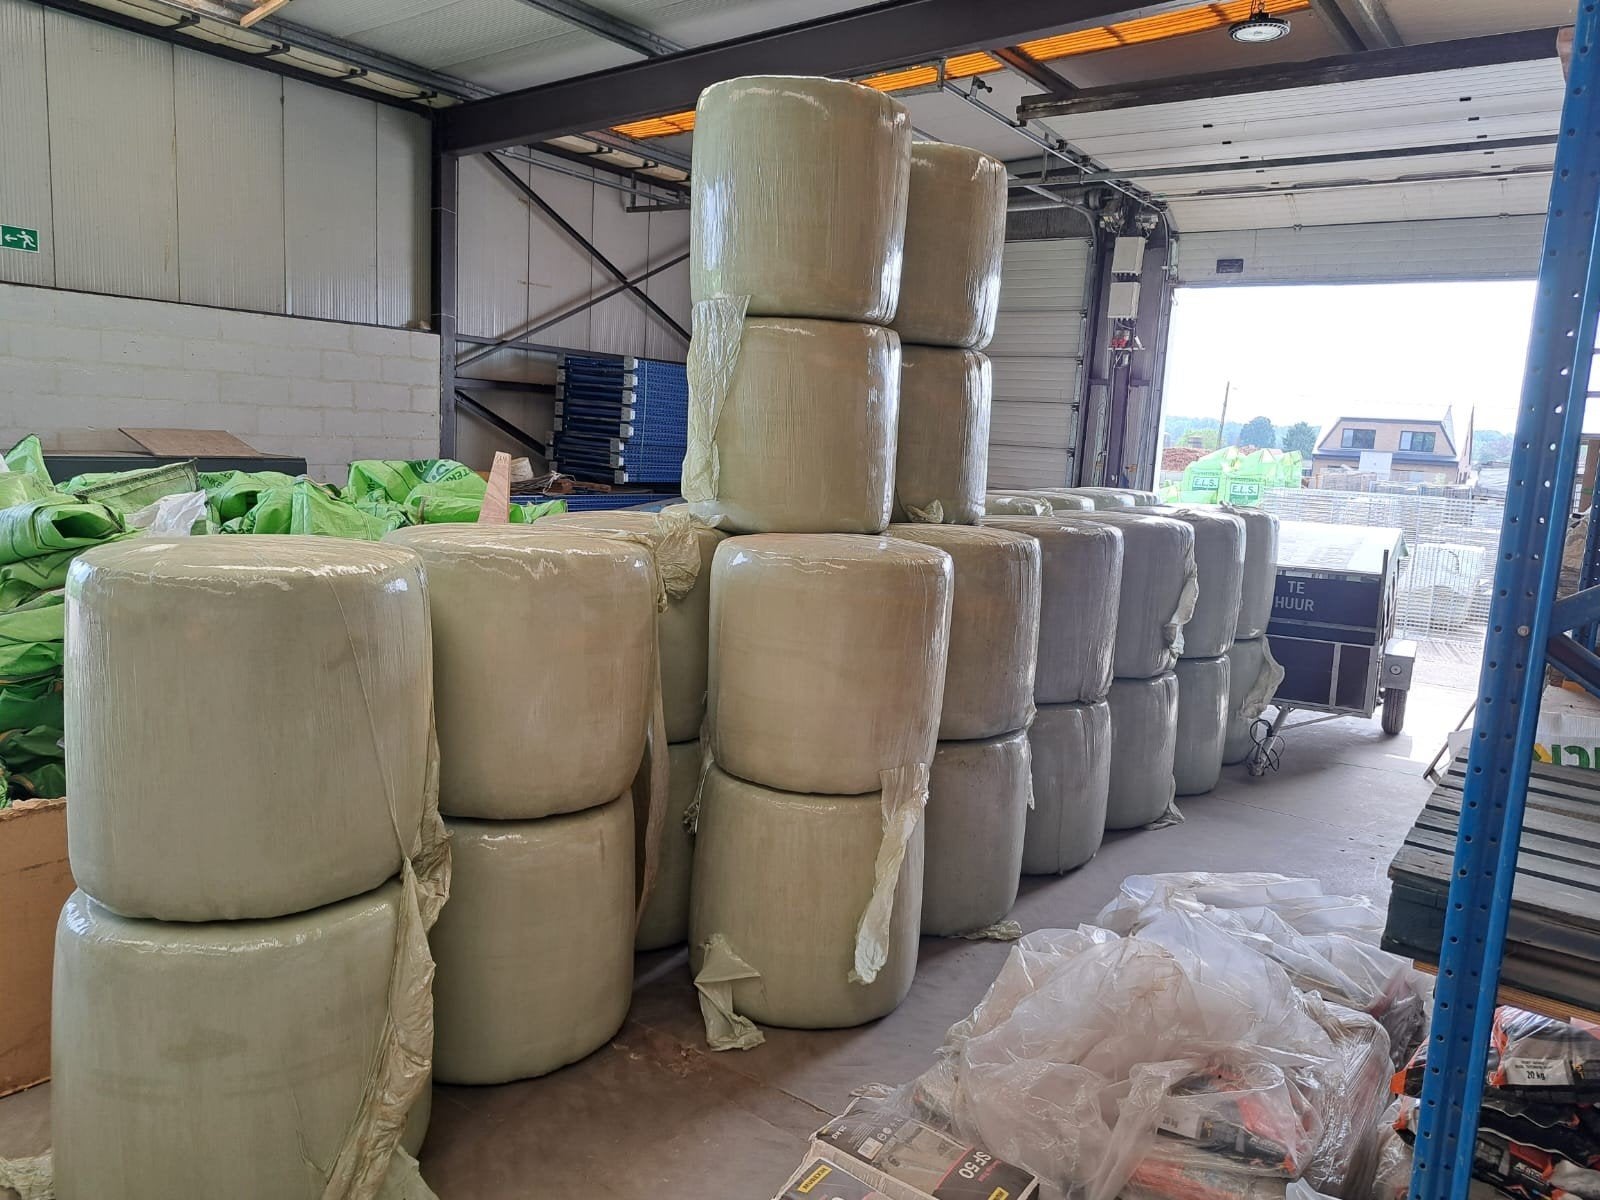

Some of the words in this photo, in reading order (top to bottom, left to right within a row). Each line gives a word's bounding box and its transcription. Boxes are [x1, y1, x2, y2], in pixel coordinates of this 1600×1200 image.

[1231, 485, 1257, 494] E.L.S.
[1287, 580, 1305, 594] TE
[1274, 596, 1314, 612] HUUR
[973, 1151, 992, 1166] SF
[958, 1161, 980, 1179] 50
